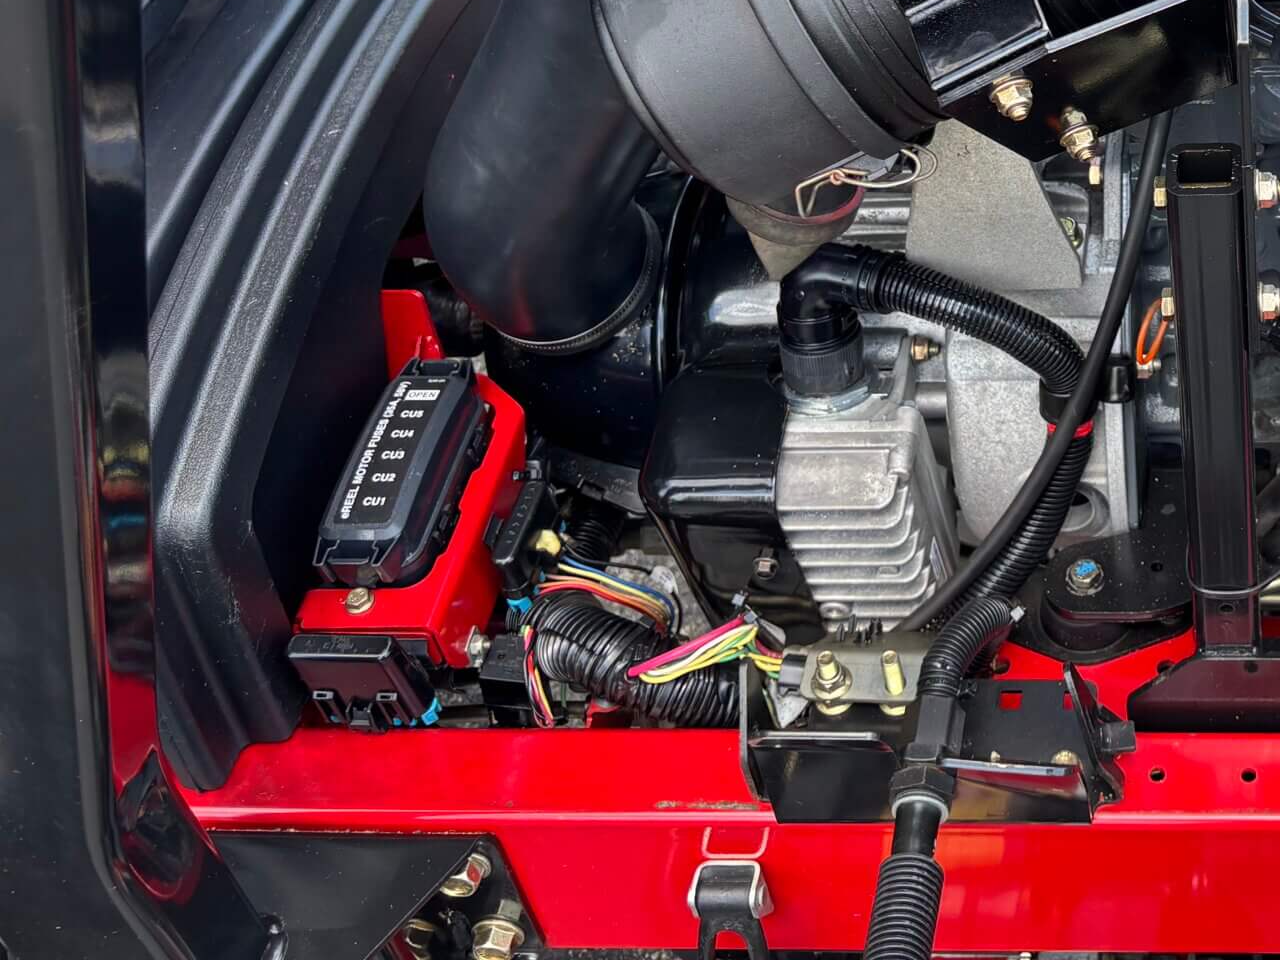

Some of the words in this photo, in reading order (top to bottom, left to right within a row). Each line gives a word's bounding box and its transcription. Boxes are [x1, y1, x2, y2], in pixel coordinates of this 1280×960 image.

[408, 391, 436, 399] OPEN
[400, 409, 425, 418] CU5
[390, 429, 415, 438] CU4
[352, 450, 375, 485] MOTOR
[368, 418, 390, 447] FUSES
[381, 450, 405, 460] CU3
[371, 472, 396, 483] CU2
[362, 496, 386, 507] CU1
